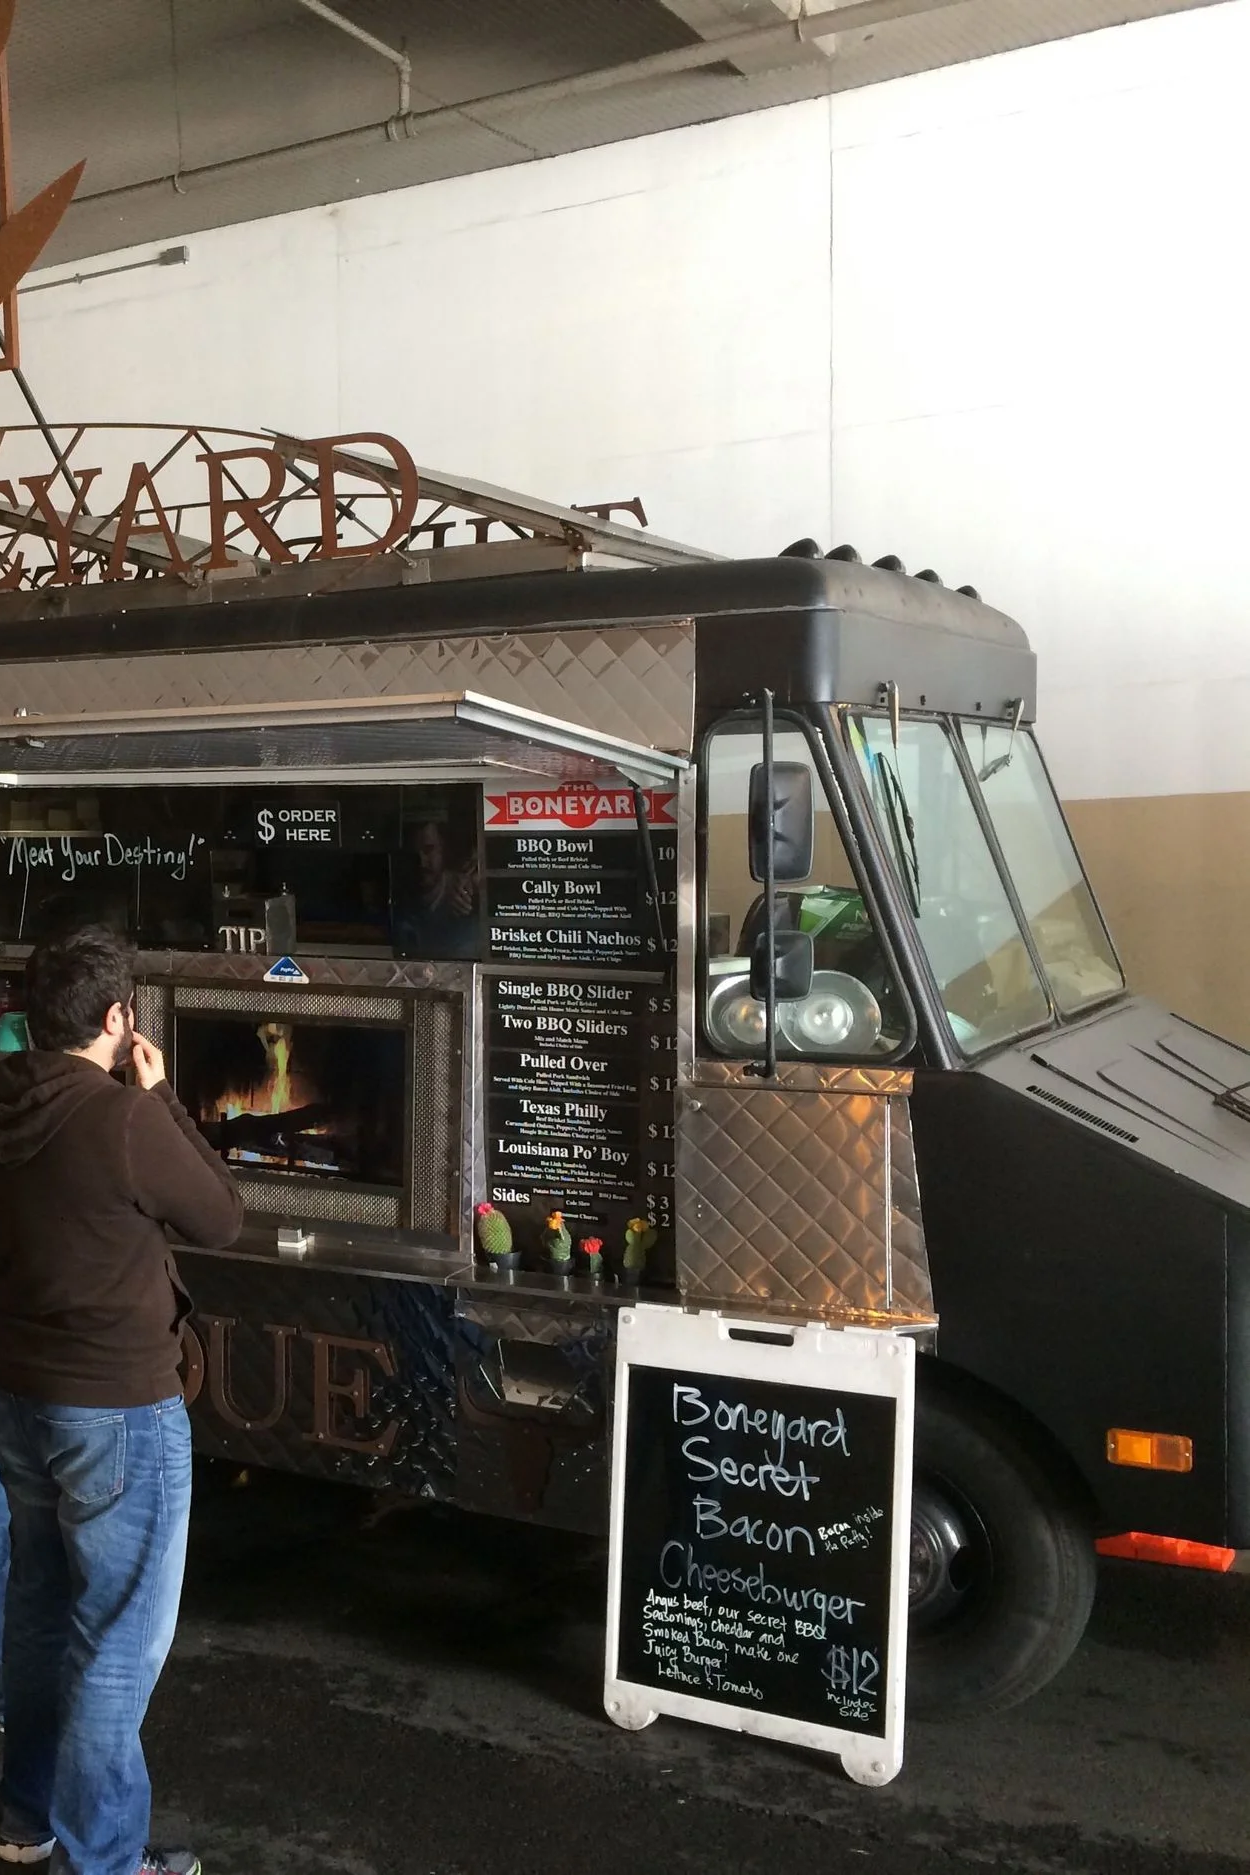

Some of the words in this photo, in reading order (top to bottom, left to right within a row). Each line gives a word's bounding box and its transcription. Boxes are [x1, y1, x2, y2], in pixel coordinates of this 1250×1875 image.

[561, 783, 596, 792] THE
[278, 808, 337, 823] ORDER
[285, 827, 332, 842] HERE
[61, 836, 101, 881] Your
[516, 838, 552, 855] BBQ
[556, 838, 594, 853] Bowl
[657, 846, 675, 861] 10
[521, 880, 560, 897] Cally
[564, 880, 601, 895] Bowl
[660, 891, 677, 905] 12
[218, 925, 266, 953] TIP
[490, 928, 542, 943] Brisket
[546, 929, 582, 944] Chili
[586, 931, 641, 946] Nachos
[498, 980, 543, 999] Single
[546, 983, 583, 1002] BBQ
[586, 985, 633, 1000] Slider
[501, 1014, 533, 1029] Two
[536, 1016, 572, 1034] BBQ
[575, 1019, 628, 1036] Sliders
[520, 1053, 566, 1070] Pulled
[570, 1057, 608, 1072] Over
[519, 1099, 561, 1116] Texas
[564, 1102, 607, 1121] Philly
[498, 1139, 569, 1158] Louisiana
[601, 1147, 630, 1165] Boy
[492, 1187, 530, 1204] Sides
[672, 1382, 851, 1466] Boneyard
[681, 1435, 821, 1501] Secret
[692, 1493, 816, 1556] Bacon
[817, 1522, 851, 1541] Bacon
[851, 1505, 884, 1524] inside
[659, 1540, 867, 1632] Cheeseburger
[643, 1605, 708, 1634] Seasonings,
[711, 1616, 753, 1641] cheddar
[759, 1632, 785, 1648] and
[646, 1588, 679, 1608] Angus
[683, 1593, 713, 1618] beef,
[718, 1606, 740, 1621] our
[747, 1610, 787, 1632] secret
[795, 1619, 827, 1641] BBQ
[642, 1623, 691, 1645] Smoked
[695, 1629, 730, 1652] Bacon
[735, 1641, 772, 1663] make
[777, 1651, 799, 1665] one
[643, 1638, 678, 1667] Juicy
[682, 1645, 728, 1677] Burger!
[820, 1643, 880, 1697] $12
[825, 1688, 878, 1713] includes
